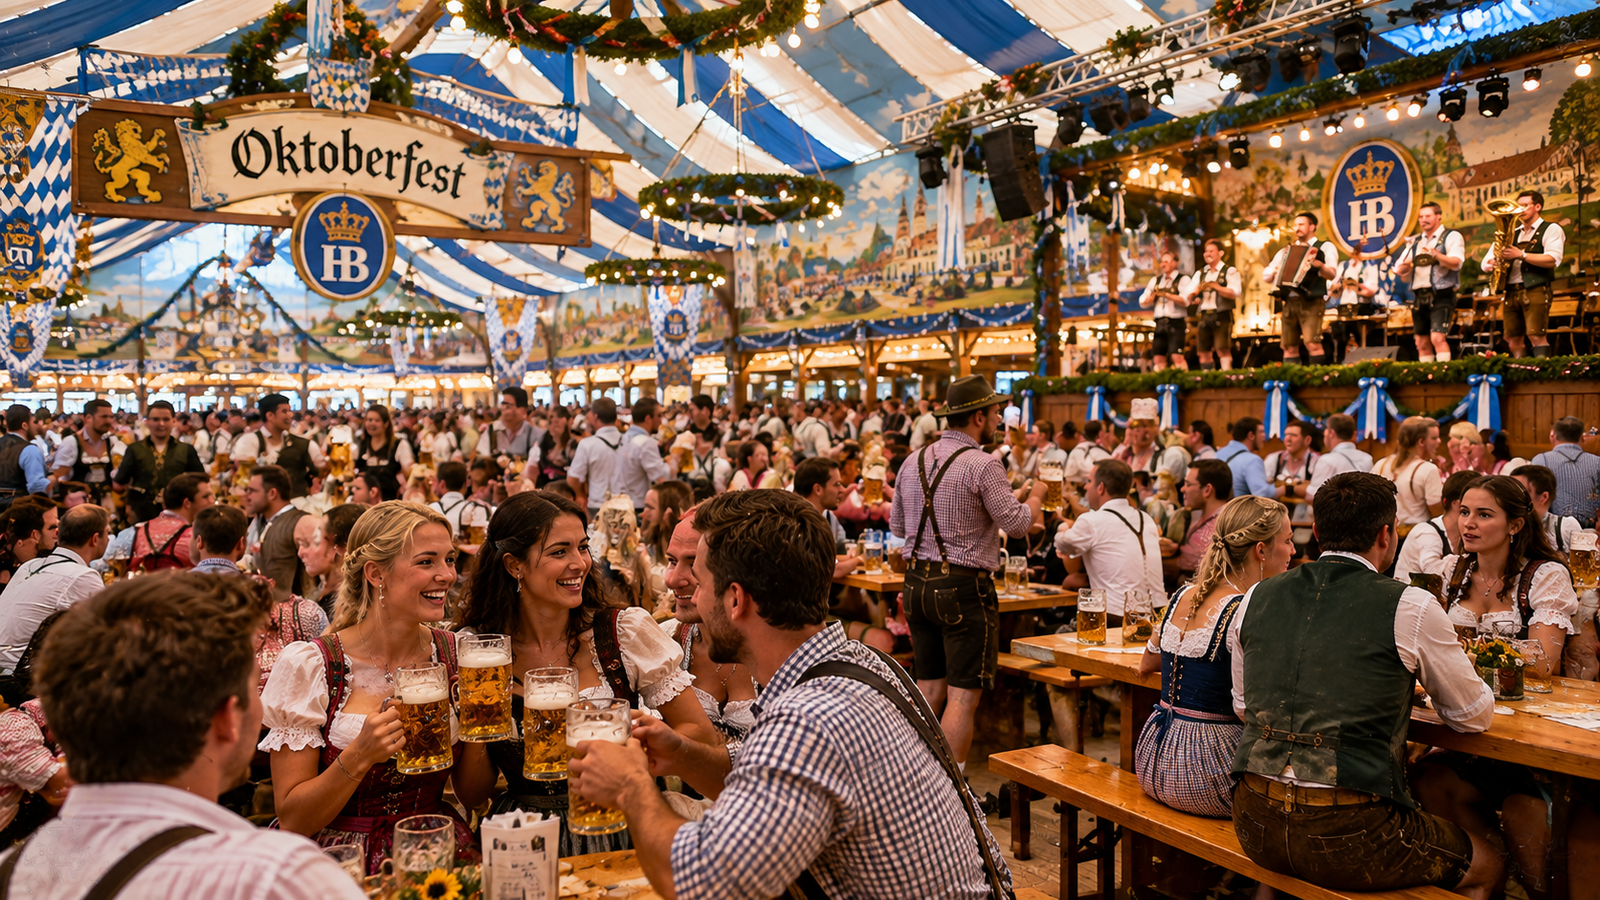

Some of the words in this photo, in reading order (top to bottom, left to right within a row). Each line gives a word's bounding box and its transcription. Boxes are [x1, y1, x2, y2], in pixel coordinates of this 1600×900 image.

[231, 126, 466, 199] Oktoberfest
[1347, 196, 1395, 241] HB
[321, 244, 370, 282] HB
